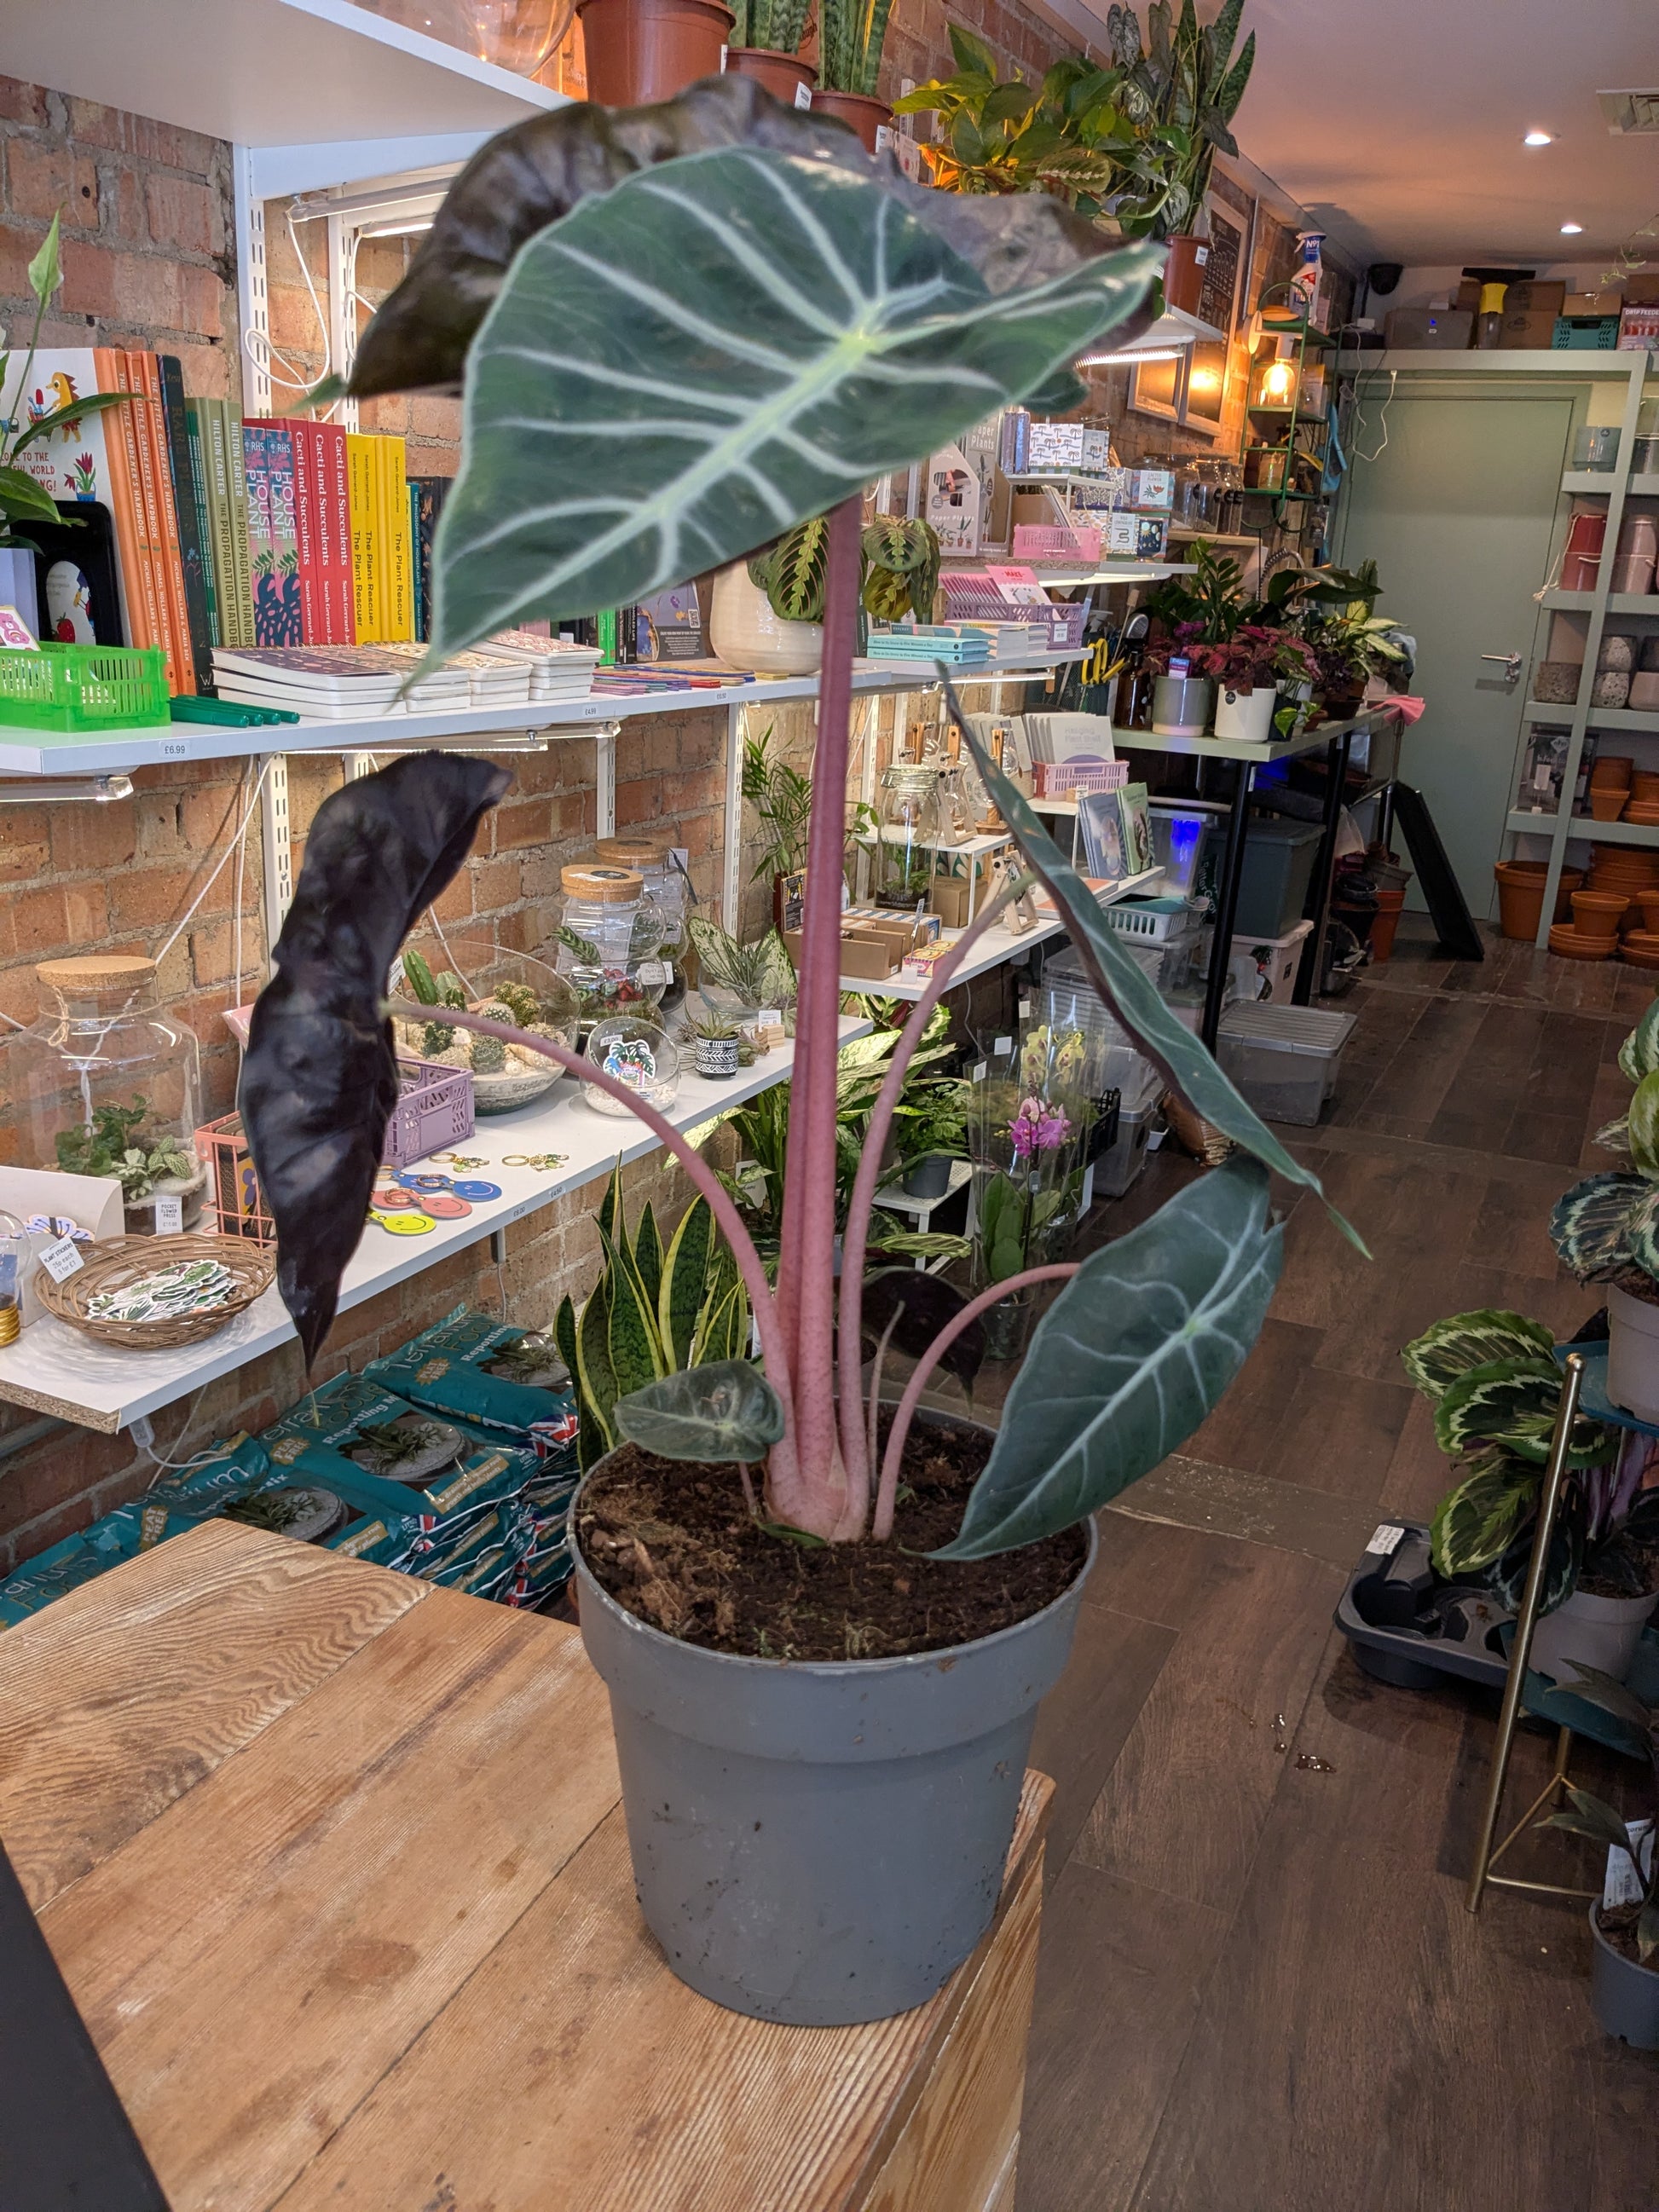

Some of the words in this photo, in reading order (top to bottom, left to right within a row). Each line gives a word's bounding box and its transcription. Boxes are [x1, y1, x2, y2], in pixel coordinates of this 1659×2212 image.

[212, 419, 221, 455] HILTON
[230, 421, 240, 458] HILTON
[251, 442, 265, 452] RHS
[277, 443, 291, 453] RHS
[295, 431, 305, 465] Cacti
[315, 434, 325, 468] Cacti
[335, 436, 345, 469] Cacti
[971, 436, 995, 450] Plants
[22, 452, 32, 461] TO
[34, 452, 49, 462] THE
[30, 465, 55, 475] WORLD
[122, 400, 131, 427] ITTLE
[134, 490, 145, 538] HANDBOOK
[215, 459, 225, 495] CARTER
[233, 459, 243, 497] CARTER
[298, 468, 307, 494] and
[317, 471, 327, 495] and
[337, 471, 346, 496] and
[147, 491, 159, 539] HANDBOOK
[165, 491, 176, 538] HANDBOOK
[246, 470, 261, 538] PLANT
[256, 470, 271, 540] HOUSE
[271, 471, 285, 539] PLANT
[282, 471, 296, 540] HOUSE
[299, 496, 310, 565] Succulents
[319, 498, 330, 566] Succulents
[338, 499, 349, 566] Succulents
[220, 520, 234, 601] PROPAGATION
[237, 522, 251, 601] PROPAGATION
[165, 745, 186, 754] £6.99
[43, 1253, 55, 1262] PLANT
[55, 1242, 73, 1256] STICKERS
[52, 1261, 62, 1269] 25p
[62, 1253, 74, 1263] each
[460, 1324, 515, 1362] Repotting
[419, 1361, 436, 1379] PEAT
[430, 1361, 449, 1380] FREE
[322, 1403, 389, 1445] Repotting
[273, 1438, 295, 1459] PEAT
[284, 1440, 307, 1461] FREE
[143, 1506, 158, 1543] PEAT
